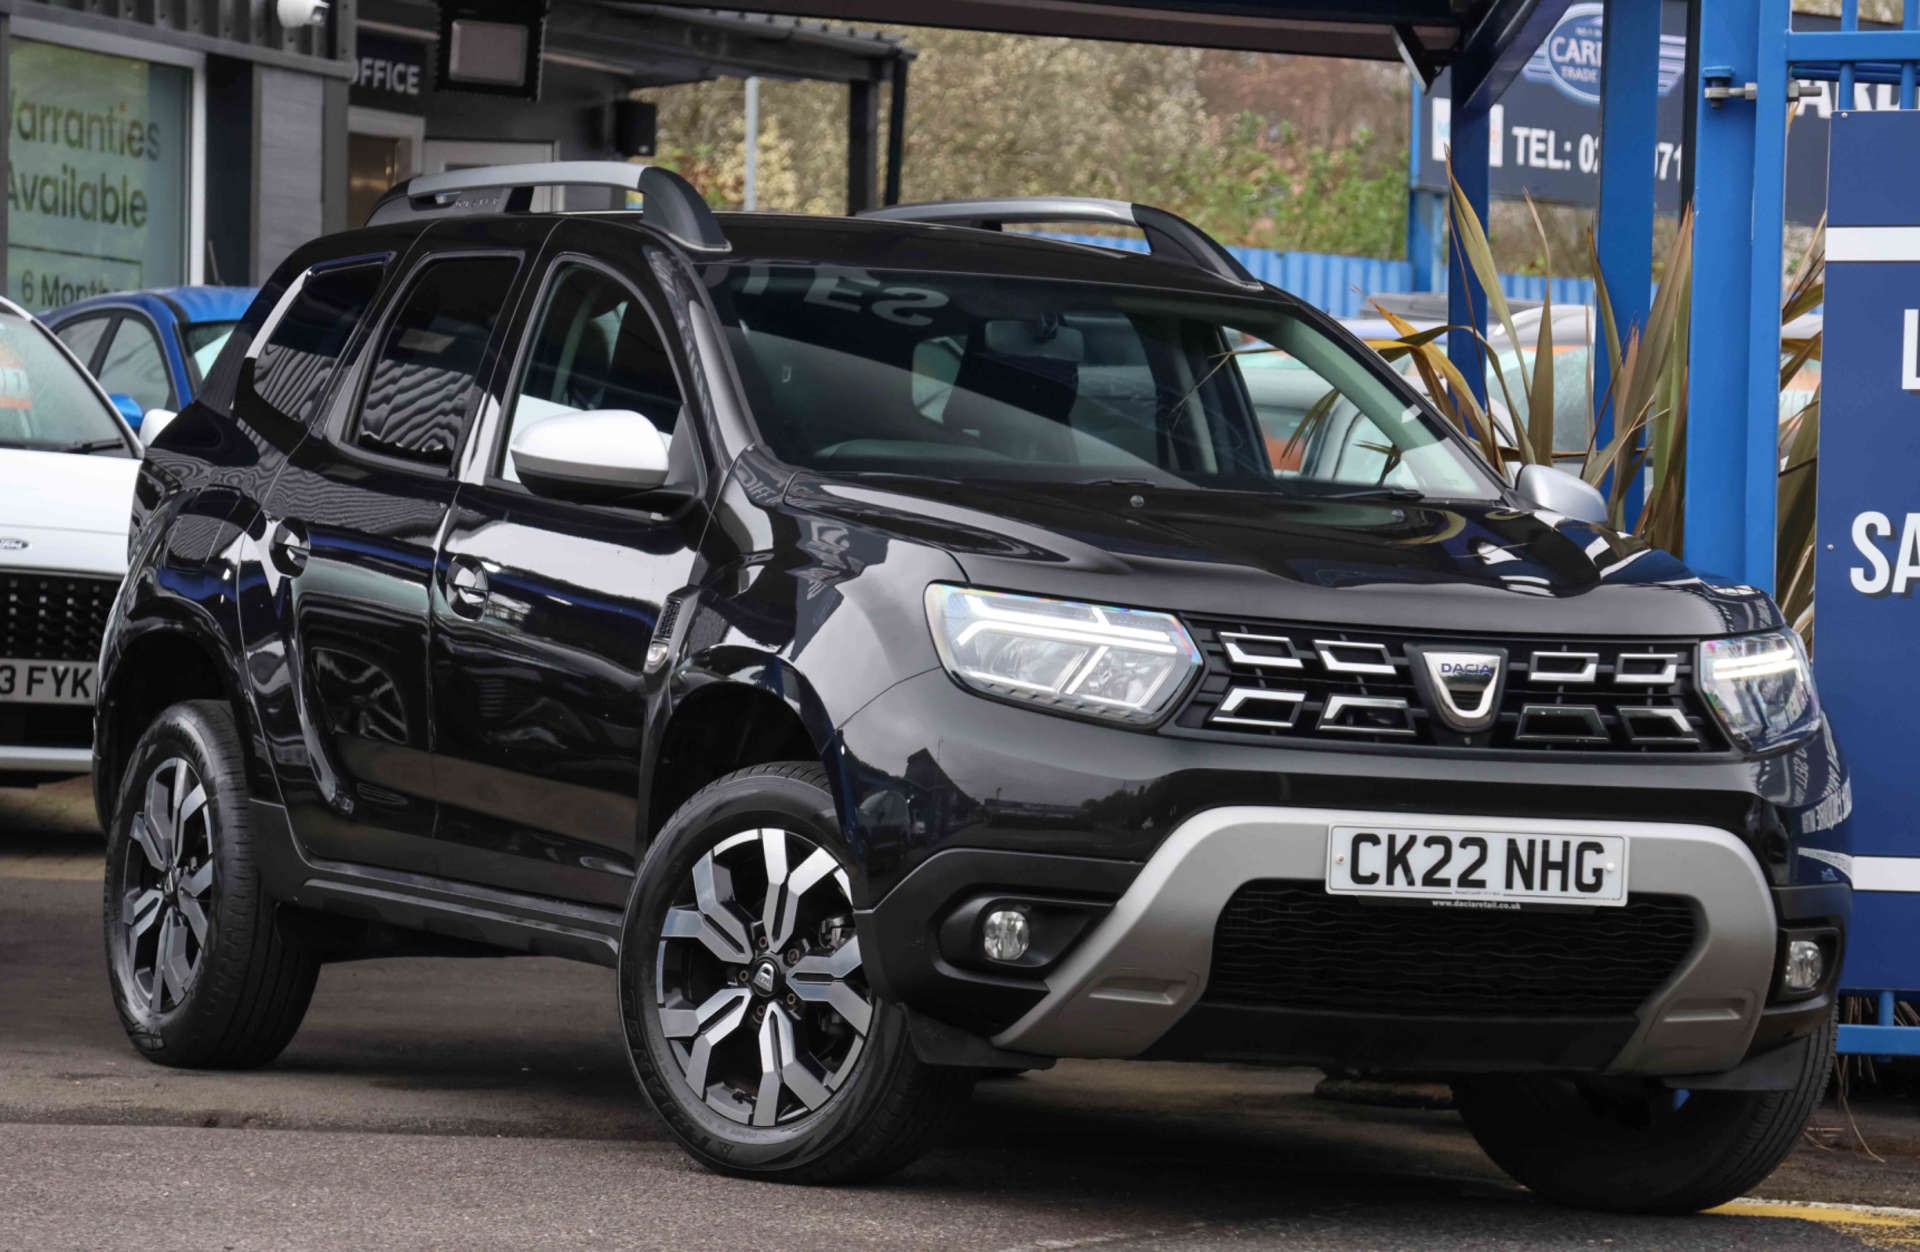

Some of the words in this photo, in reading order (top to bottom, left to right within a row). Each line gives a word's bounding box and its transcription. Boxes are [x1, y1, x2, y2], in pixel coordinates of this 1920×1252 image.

[9, 92, 160, 161] arranties
[1511, 126, 1572, 171] TEL:
[22, 270, 34, 303] 6
[26, 665, 92, 699] FYK
[1441, 663, 1492, 673] DACIA
[1350, 833, 1489, 889] CK22
[1505, 838, 1605, 893] NHG
